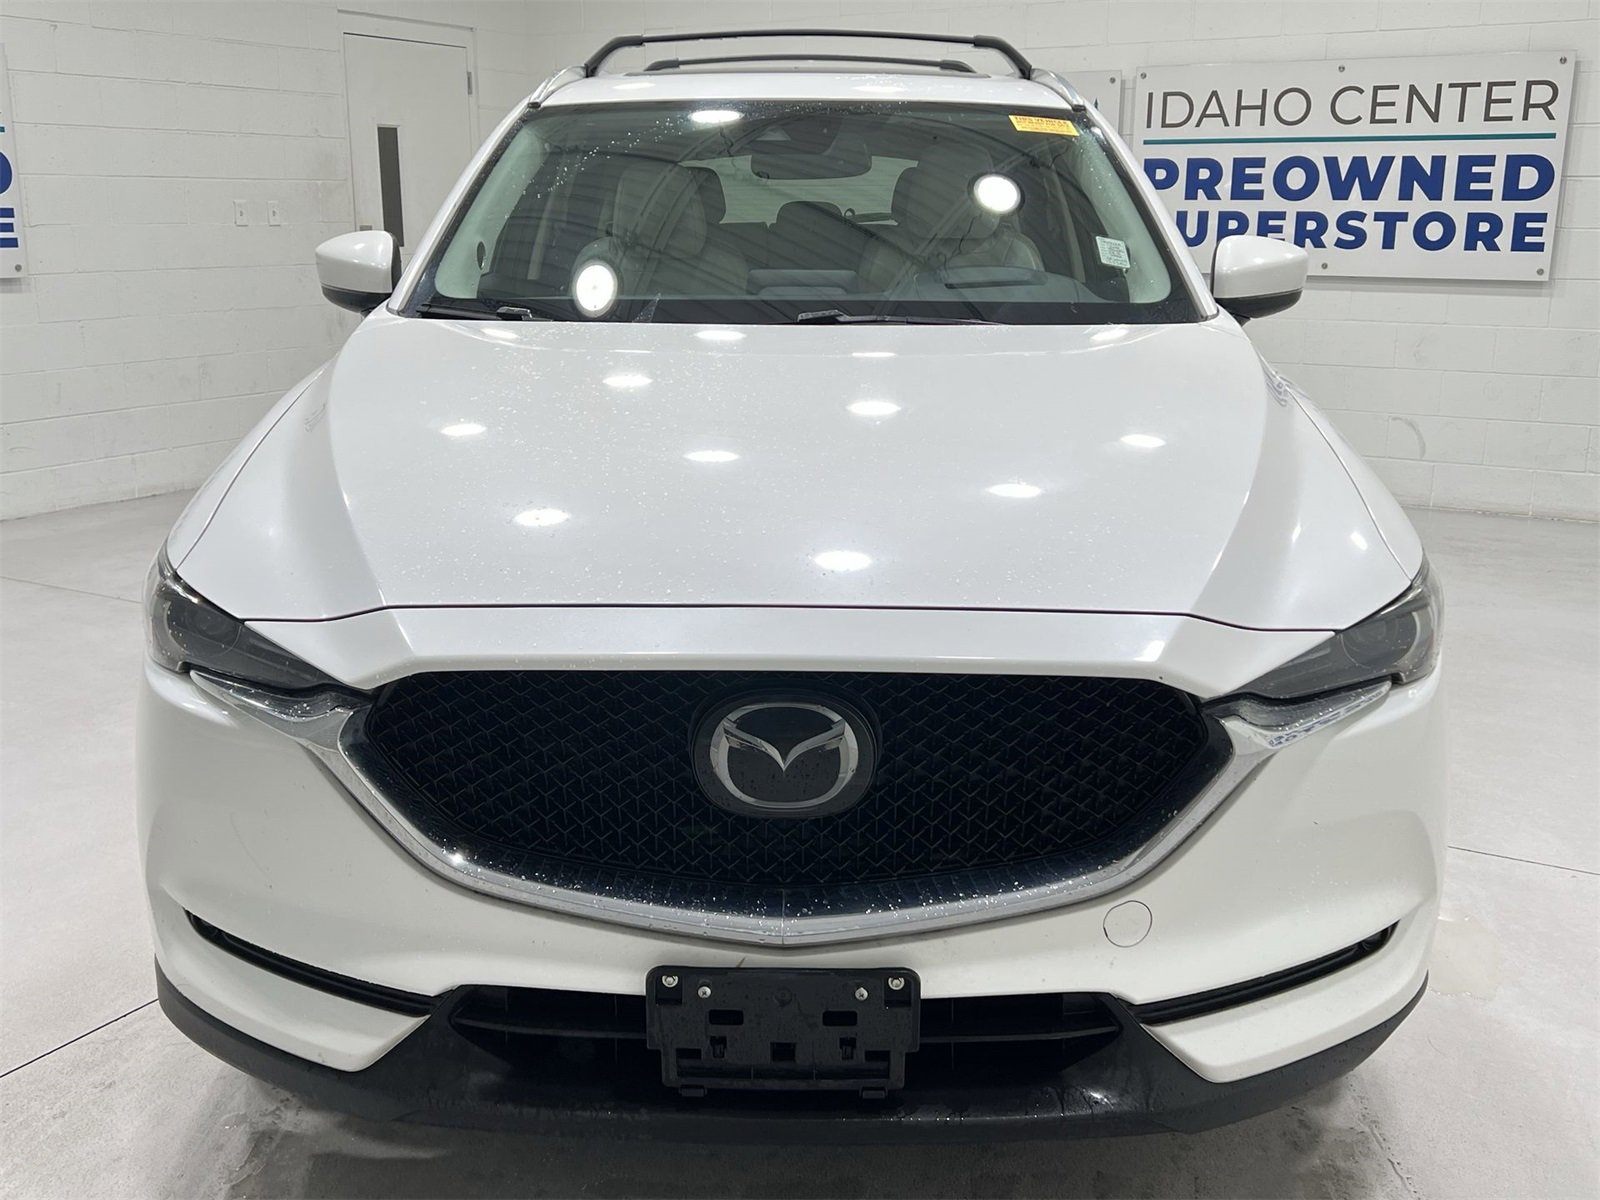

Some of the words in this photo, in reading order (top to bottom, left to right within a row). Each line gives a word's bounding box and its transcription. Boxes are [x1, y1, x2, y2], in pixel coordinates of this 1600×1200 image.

[1146, 87, 1311, 128] IDAHO
[1330, 80, 1559, 125] CENTER
[1143, 154, 1555, 201] PREOWNED
[1176, 210, 1548, 252] UPERSTORE
